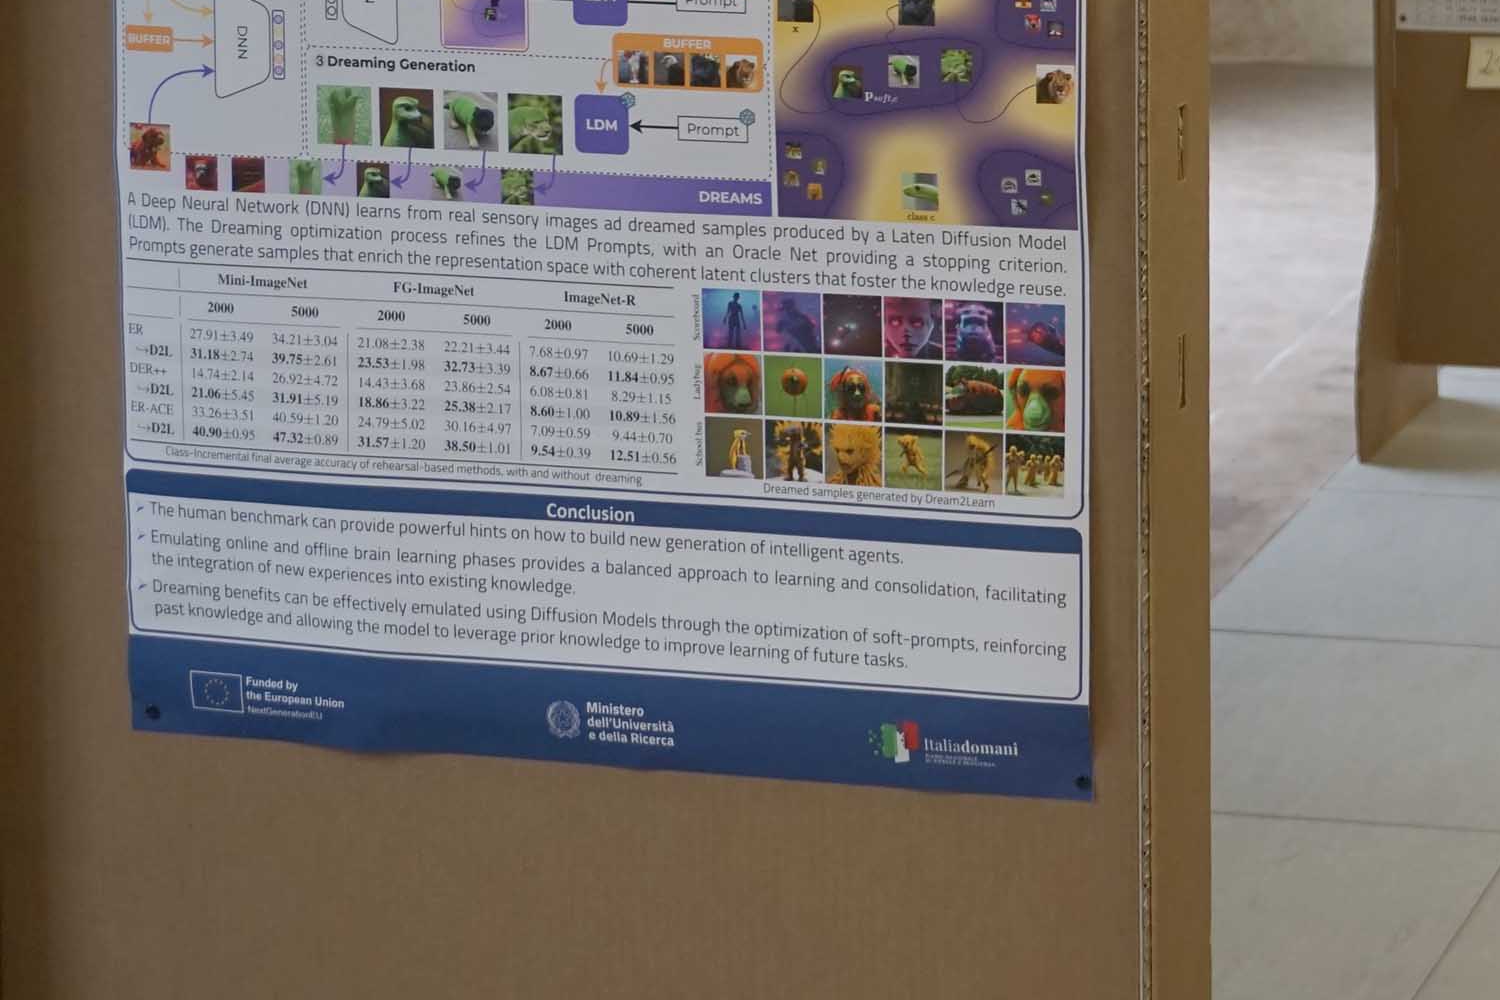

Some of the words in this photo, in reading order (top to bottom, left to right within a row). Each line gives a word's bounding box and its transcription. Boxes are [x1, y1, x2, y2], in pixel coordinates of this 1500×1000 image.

[128, 34, 171, 46] BUFFER
[663, 38, 712, 50] BUFFER
[316, 55, 324, 67] 3
[327, 55, 396, 72] Dreaming
[399, 58, 476, 73] Generation
[586, 119, 617, 132] LDM
[687, 122, 740, 138] Prompt
[699, 190, 763, 205] DREAMS
[218, 273, 307, 290] Mini-ImageNet
[393, 281, 474, 297] FG-ImageNet
[564, 290, 636, 306] ImageNet-R
[207, 301, 234, 314] 2000
[291, 305, 319, 317] 5000
[610, 450, 677, 466] 12.51±0.56
[763, 482, 810, 496] Dreamed
[811, 487, 855, 500] samples
[856, 490, 909, 503] generated
[910, 492, 923, 505] by
[925, 493, 996, 508] Dream2Learn
[546, 502, 635, 523] Conclusion
[150, 501, 174, 518] The
[178, 503, 226, 521] human
[230, 508, 309, 527] benchmark
[312, 517, 336, 529] can
[340, 518, 395, 534] provide
[399, 520, 465, 537] powerful
[470, 522, 507, 539] hints
[511, 528, 530, 540] on
[534, 526, 566, 543] how
[570, 529, 586, 544] to
[590, 529, 625, 546] build
[629, 535, 661, 548] new
[665, 537, 746, 553] generation
[750, 539, 766, 555] of
[769, 542, 845, 563] intelligent
[848, 549, 904, 566] agents.
[246, 676, 284, 689] Funded
[285, 679, 298, 693] by
[246, 690, 262, 701] the
[264, 691, 313, 706] European
[315, 696, 345, 709] Union
[586, 701, 645, 717] Ministero
[588, 731, 596, 740] e
[598, 730, 628, 743] della
[630, 732, 675, 747] Ricerca
[924, 738, 1018, 756] Italiadomani
